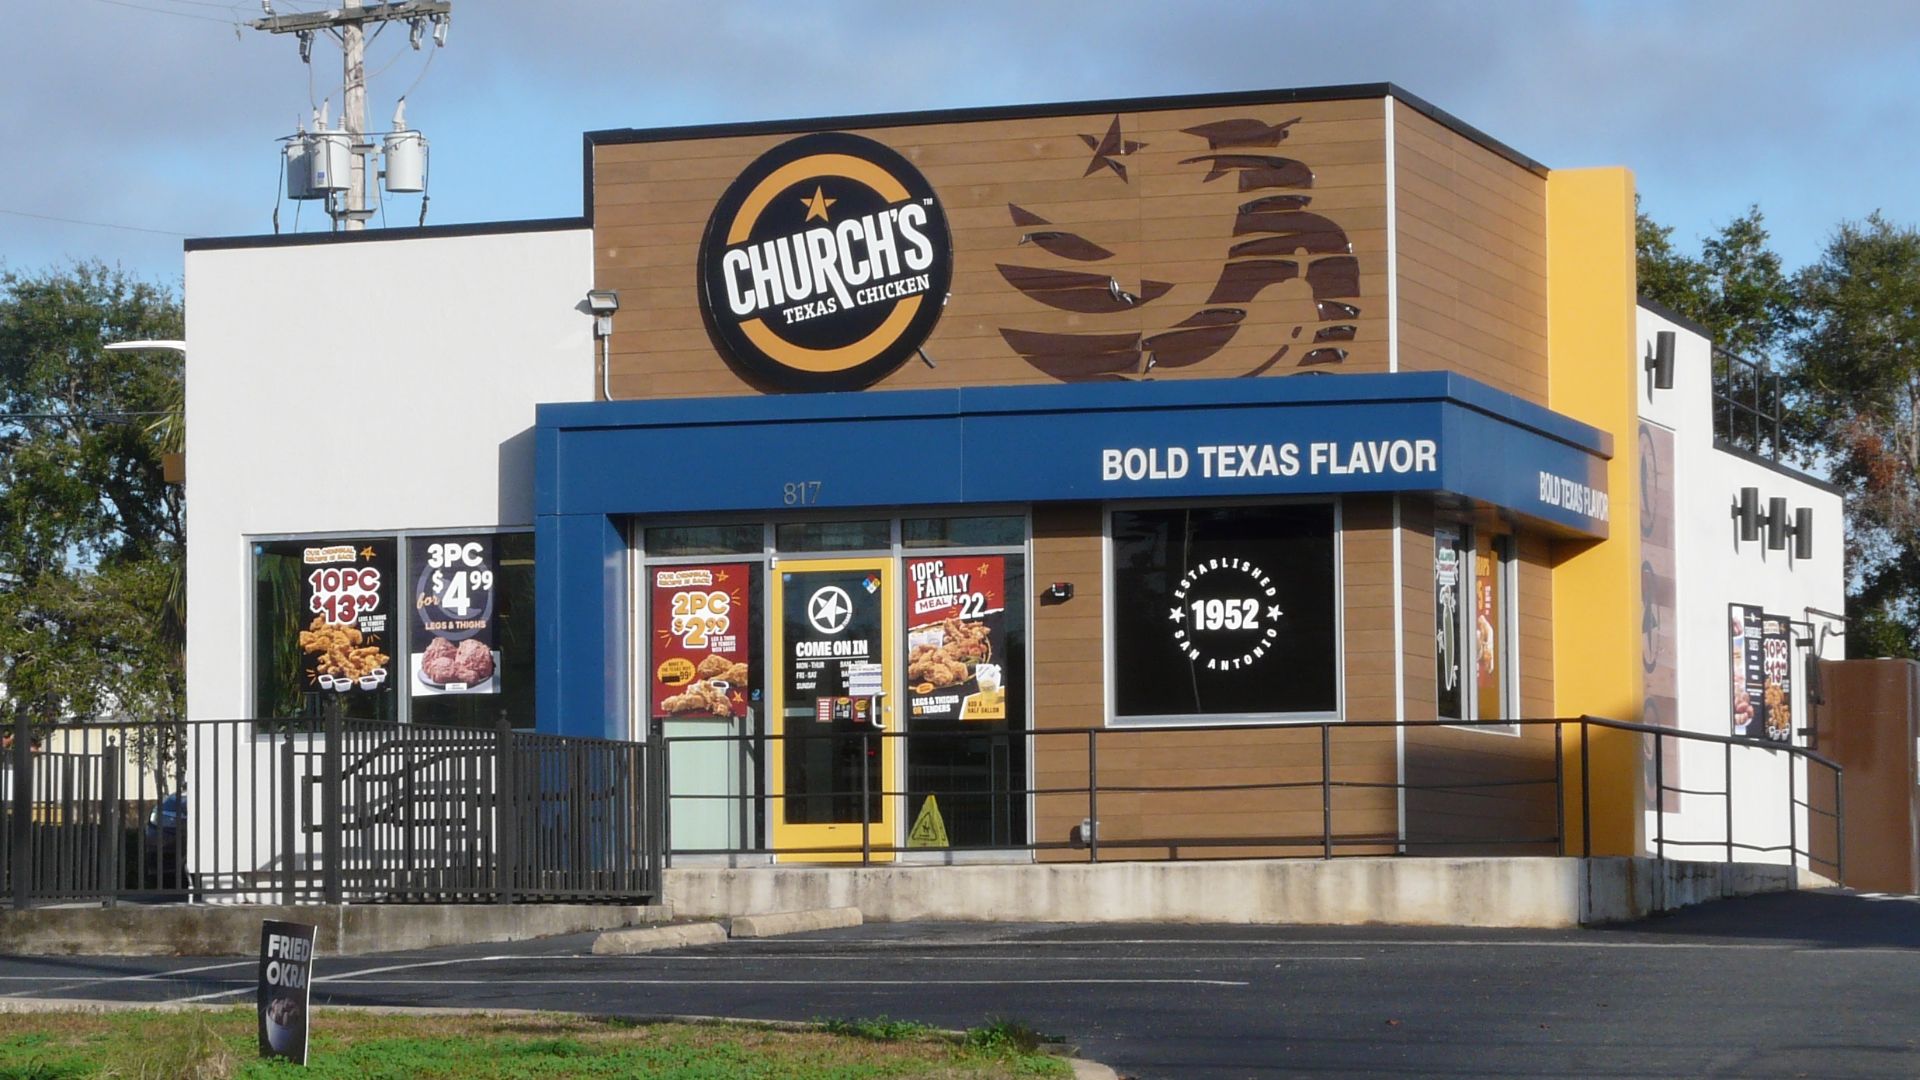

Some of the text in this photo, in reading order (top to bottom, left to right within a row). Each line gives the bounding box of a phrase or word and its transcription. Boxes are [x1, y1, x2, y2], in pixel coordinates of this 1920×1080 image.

[722, 203, 934, 315] CHURCH'S
[783, 273, 930, 324] TEXAS CHICKEN
[1102, 439, 1437, 481] BOLD TEXAS FLAVOR
[783, 481, 822, 505] 817
[1539, 470, 1608, 522] BOLD TEXAS FLAVOR
[427, 542, 483, 569] 3PC
[310, 569, 379, 593] 10PC
[910, 560, 944, 581] 10PC
[1174, 557, 1277, 599] ESTABLISHED
[916, 573, 969, 598] FAMILY
[673, 592, 730, 616] 2PC
[919, 598, 949, 611] MEAL
[1190, 598, 1259, 630] 1952
[425, 622, 447, 631] LEGS
[455, 620, 487, 629] THIGHS
[796, 640, 868, 657] COME ON IN
[1174, 628, 1277, 671] SAN ANTONIO
[1763, 639, 1788, 660] 10PC
[912, 697, 929, 706] LEGS
[922, 704, 951, 714] TENDERS
[267, 933, 311, 962] FRIED
[266, 961, 307, 989] OKRA
